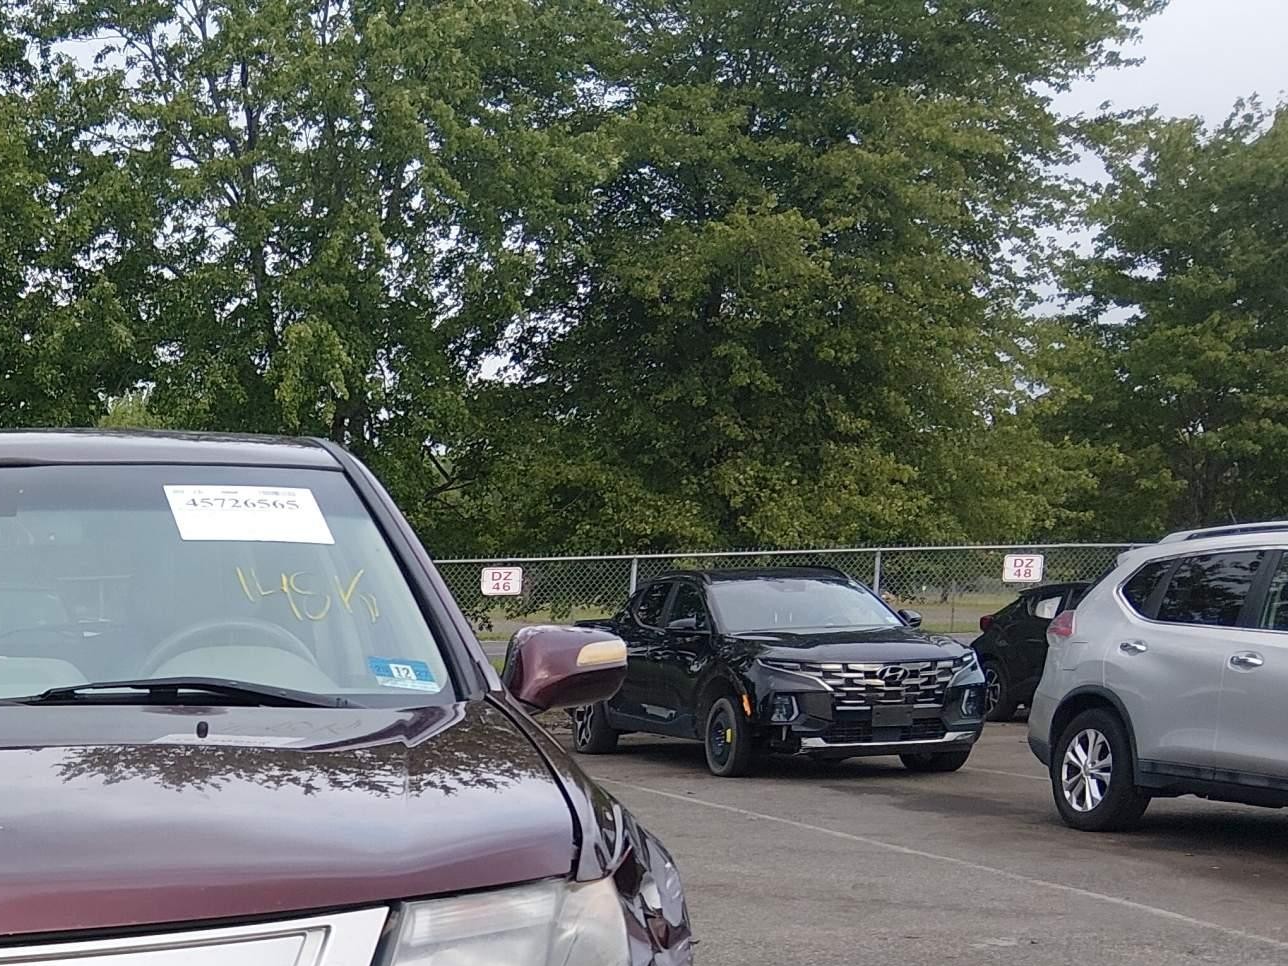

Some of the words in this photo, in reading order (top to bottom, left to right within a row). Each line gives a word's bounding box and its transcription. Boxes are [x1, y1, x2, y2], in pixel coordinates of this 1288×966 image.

[185, 498, 300, 510] 45726565
[1014, 559, 1034, 568] DZ
[492, 572, 512, 581] DZ
[1014, 569, 1032, 578] 48
[492, 582, 511, 591] 46
[394, 666, 412, 679] 12
